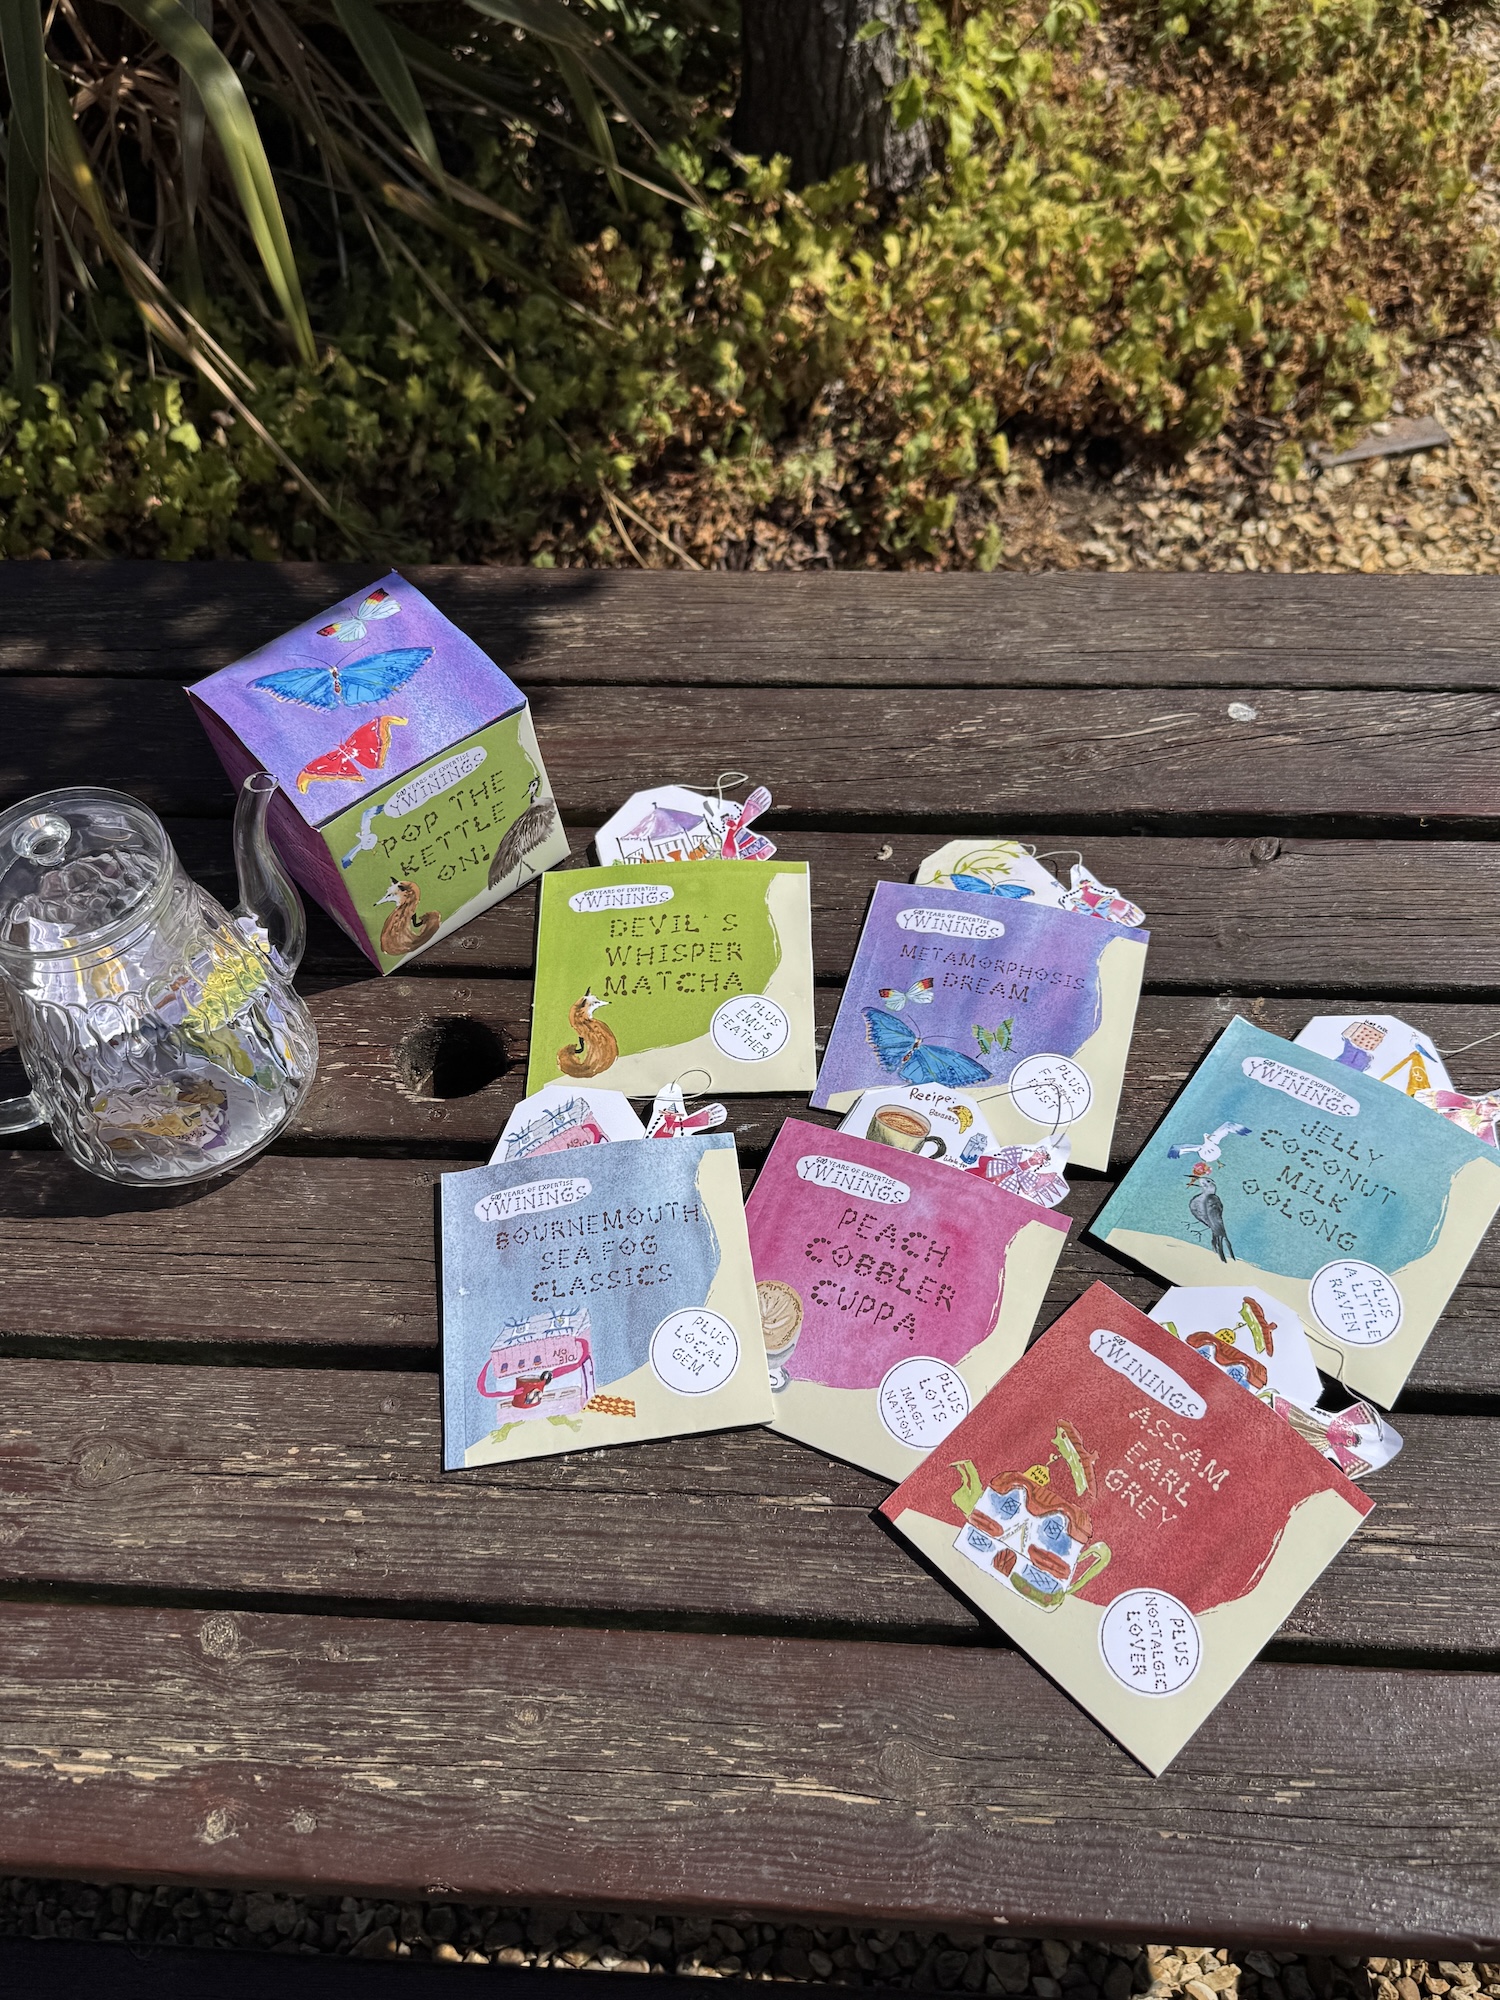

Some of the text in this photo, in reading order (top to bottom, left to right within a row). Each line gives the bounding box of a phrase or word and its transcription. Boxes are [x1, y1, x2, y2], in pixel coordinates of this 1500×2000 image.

[390, 753, 484, 816] YWININGS
[408, 777, 427, 790] YEARS
[438, 752, 470, 773] EXPERTISE
[382, 771, 506, 858] POP THE
[400, 801, 506, 876] KETTLE
[437, 844, 490, 881] ON!
[575, 892, 669, 912] YWININGS
[926, 910, 946, 918] YEARS
[957, 916, 990, 925] EXPERTISE
[903, 913, 999, 938] YWININGS
[605, 941, 743, 967] WHISPER
[900, 944, 1086, 990] METAMORPHOSIS
[603, 971, 743, 996] MATCHA
[942, 972, 1030, 1003] DREAM
[717, 1013, 769, 1056] FEATHER
[750, 1001, 782, 1027] PLUS
[909, 1087, 957, 1107] Recipe:
[1026, 1078, 1059, 1109] DUST
[1055, 1064, 1085, 1095] PLUS
[1248, 1061, 1354, 1116] YWININGS
[1276, 1064, 1298, 1078] YEARS
[1299, 1075, 1310, 1084] OF
[1310, 1079, 1347, 1100] EXPERTISE
[1300, 1120, 1384, 1168] JELLY
[504, 1188, 525, 1198] YEARS
[538, 1180, 574, 1191] EXPERTISE
[803, 1160, 904, 1204] YWININGS
[829, 1160, 850, 1172] YEARS
[851, 1167, 860, 1175] OF
[861, 1170, 897, 1187] EXPERTISE
[1260, 1129, 1397, 1205] COCONUT
[1276, 1165, 1348, 1213] MILK
[481, 1185, 587, 1221] YWININGS
[1242, 1178, 1358, 1251] OOLONG
[496, 1201, 699, 1250] BOURNEMOUTH
[837, 1207, 951, 1268] PEACH
[541, 1235, 658, 1271] SEA FOG
[805, 1237, 956, 1313] COBBLER
[532, 1263, 672, 1302] CLASSICS
[1344, 1267, 1382, 1339] A LITTLE
[1368, 1279, 1394, 1319] PLUS
[810, 1279, 916, 1341] CUPPA
[1329, 1278, 1361, 1333] RAVEN
[674, 1325, 722, 1367] LOCAL
[692, 1316, 730, 1346] PLUS
[672, 1347, 705, 1376] GEM
[1094, 1334, 1199, 1417] YWININGS
[885, 1390, 914, 1439] NATION
[900, 1386, 925, 1431] IMAGI-
[919, 1378, 948, 1422] LOTS
[936, 1372, 965, 1413] PLUS
[1128, 1407, 1230, 1492] ASSAM
[1124, 1440, 1191, 1508] EARL
[1105, 1469, 1178, 1530] GREY
[1126, 1611, 1147, 1676] LOVER
[1145, 1596, 1167, 1689] NOSTALGIC
[1169, 1618, 1189, 1666] PLUS
